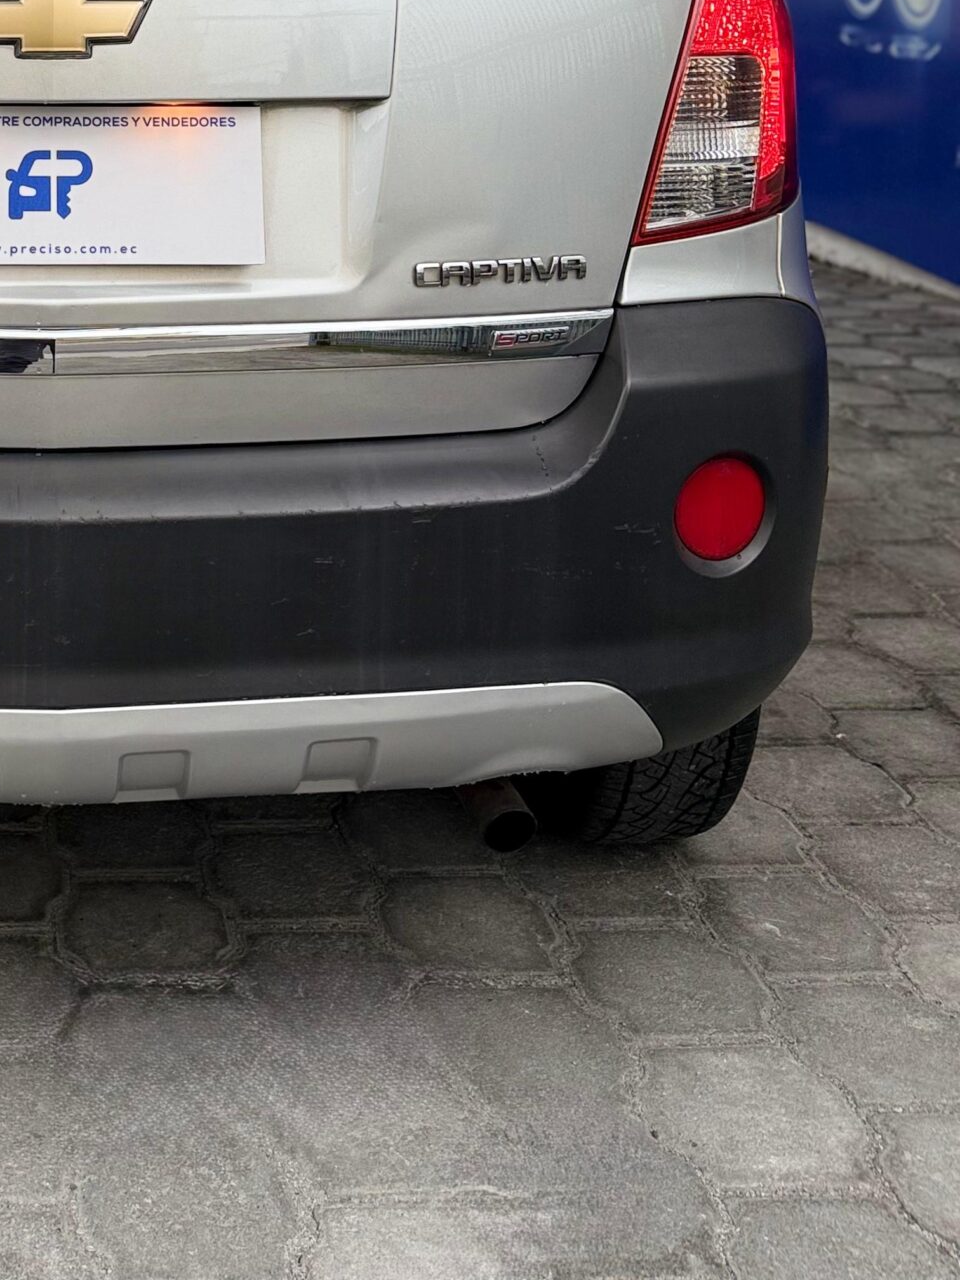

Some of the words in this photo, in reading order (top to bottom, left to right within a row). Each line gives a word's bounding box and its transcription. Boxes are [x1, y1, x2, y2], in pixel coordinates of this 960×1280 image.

[22, 114, 129, 128] COMPRADORES
[131, 114, 141, 128] Y
[142, 114, 236, 128] VENDEDORES
[413, 254, 588, 288] CAPTIVA
[497, 328, 567, 347] SPORT
